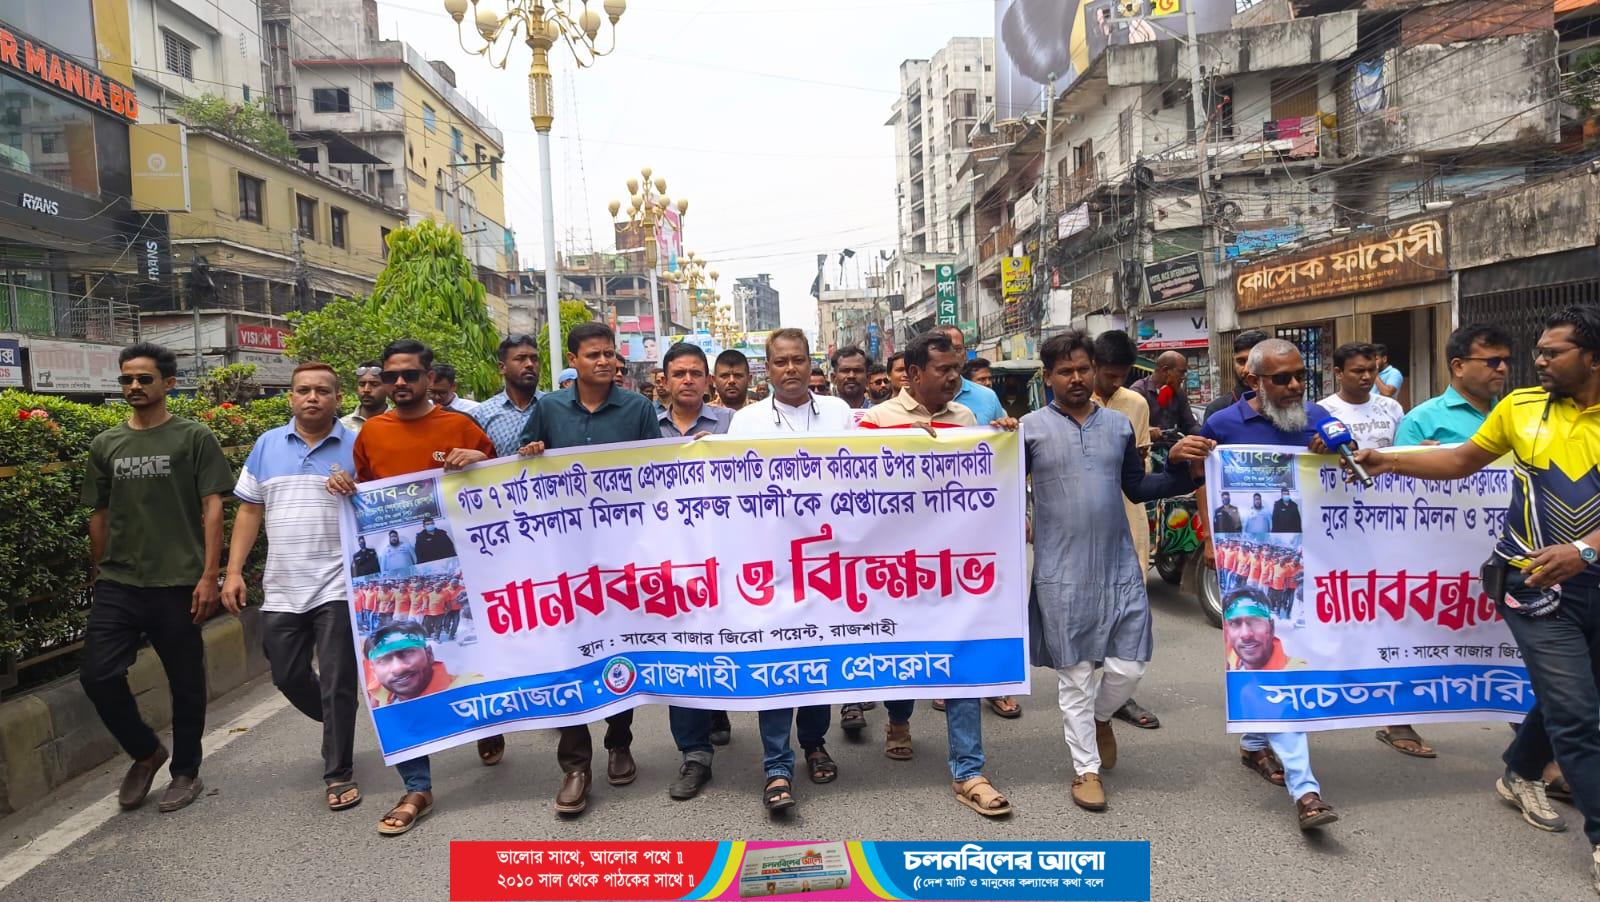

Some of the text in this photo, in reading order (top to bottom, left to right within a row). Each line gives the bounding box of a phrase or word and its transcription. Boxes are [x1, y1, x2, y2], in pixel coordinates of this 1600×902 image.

[24, 40, 107, 107] MANIA
[109, 80, 139, 120] BD
[22, 193, 59, 216] RYANS
[146, 241, 160, 282] RYANS
[1330, 220, 1444, 274] ফার্মেসী
[937, 277, 956, 297] পর্দা
[240, 330, 272, 347] VISION
[1353, 419, 1391, 434] spykar
[458, 488, 483, 514] গত
[489, 487, 501, 508] ৭
[502, 470, 527, 505] মার্চ
[530, 463, 587, 498] রাজশাহী
[591, 468, 632, 493] বরেন্দ্র
[638, 460, 705, 489] প্রেসক্লাবের
[709, 451, 764, 483] সভাপতি
[769, 449, 822, 481] রেজাউল
[826, 448, 878, 480] করিমের
[882, 447, 915, 479] উপর
[920, 442, 993, 481] হামলাকারী
[1320, 464, 1337, 493] গত
[465, 520, 509, 556] নূরে
[513, 509, 584, 542] ইসলাম
[588, 497, 645, 529] মিলন
[653, 501, 669, 520] ও
[675, 496, 732, 527] সুরুজ
[831, 488, 916, 516] গ্রেপ্তারের
[922, 480, 998, 513] দাবিতে
[1320, 505, 1349, 539] নূরে
[1352, 497, 1408, 533] ইসলাম
[1412, 497, 1457, 531] মিলন
[1463, 508, 1476, 530] ও
[481, 523, 996, 634] মানববন্ধন ও বিক্ষোভ
[578, 638, 604, 657] স্থান
[621, 632, 667, 646] সাহেব
[672, 631, 714, 645] বাজার
[718, 628, 763, 645] জিরো
[829, 618, 897, 638] রাজশাহী
[1377, 647, 1399, 661] স্থান
[1413, 645, 1449, 660] সাহেব
[1454, 645, 1493, 660] বাজার
[448, 680, 583, 720] আয়োজনে
[638, 656, 740, 693] রাজশাহী
[747, 658, 831, 688] বরেন্দ্র
[841, 651, 954, 681] প্রেসক্লাব
[1259, 669, 1537, 712] সচেতন নাগরি
